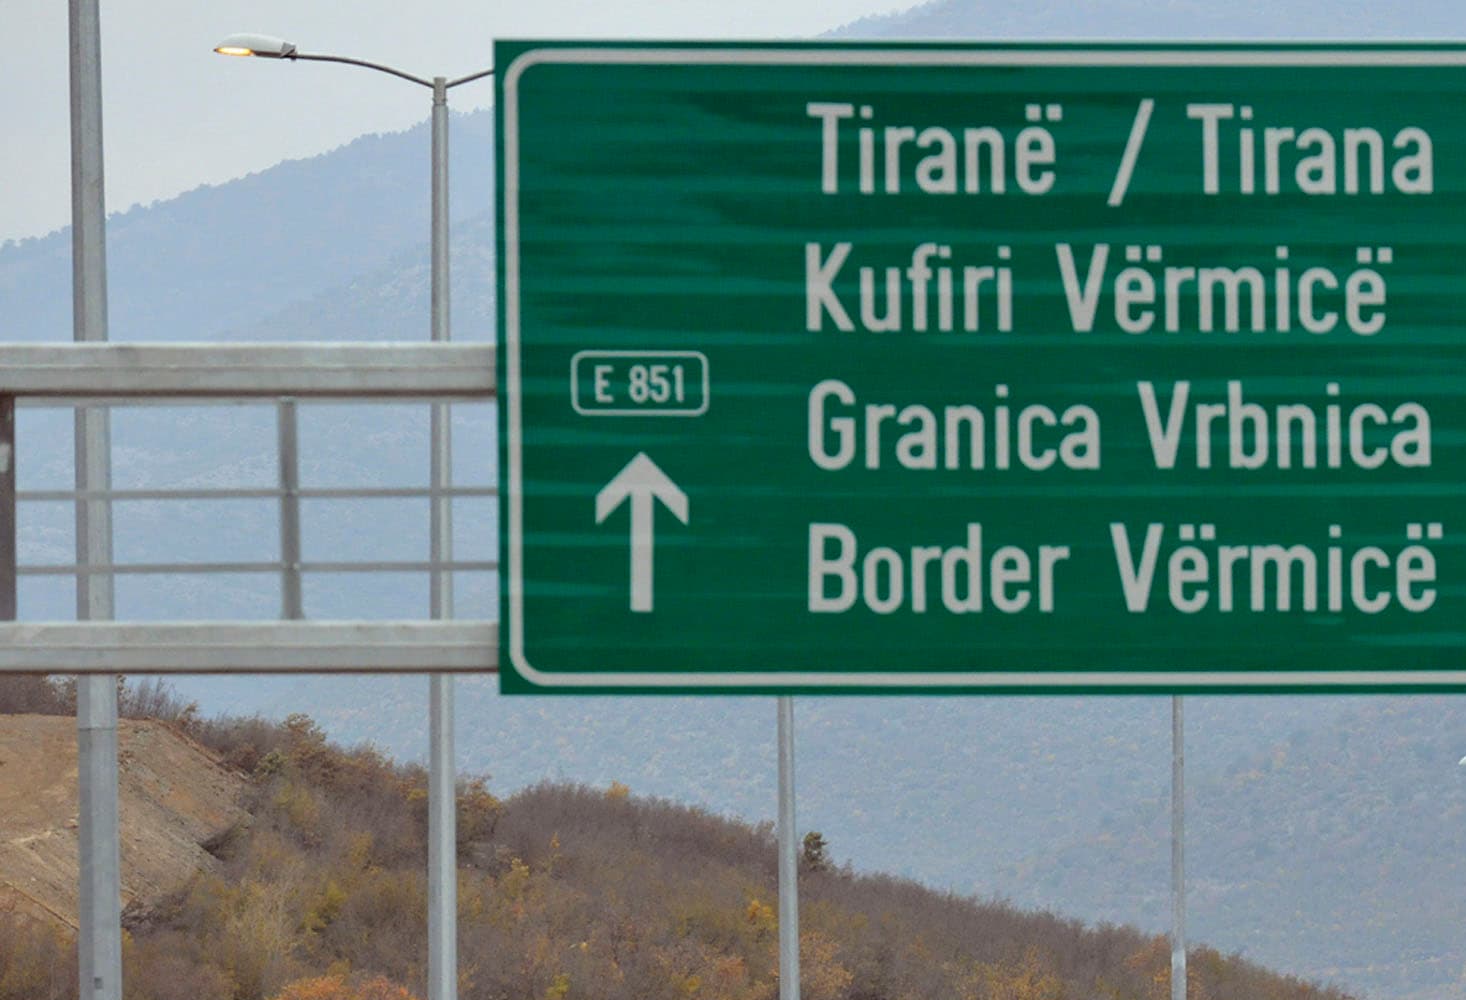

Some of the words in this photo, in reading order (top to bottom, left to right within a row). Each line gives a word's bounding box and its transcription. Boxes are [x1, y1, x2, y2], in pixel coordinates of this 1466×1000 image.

[808, 103, 1062, 194] Tiranë
[1108, 100, 1154, 206] /
[1187, 104, 1433, 194] Tirana
[806, 243, 1012, 332] Kufiri
[1056, 243, 1393, 335] Vërmicë
[594, 365, 613, 403] E
[629, 365, 684, 403] 851
[808, 379, 1100, 470] Granica
[1138, 380, 1431, 469] Vrbnica
[808, 523, 1070, 614] Border
[1110, 523, 1443, 613] Vërmicë
